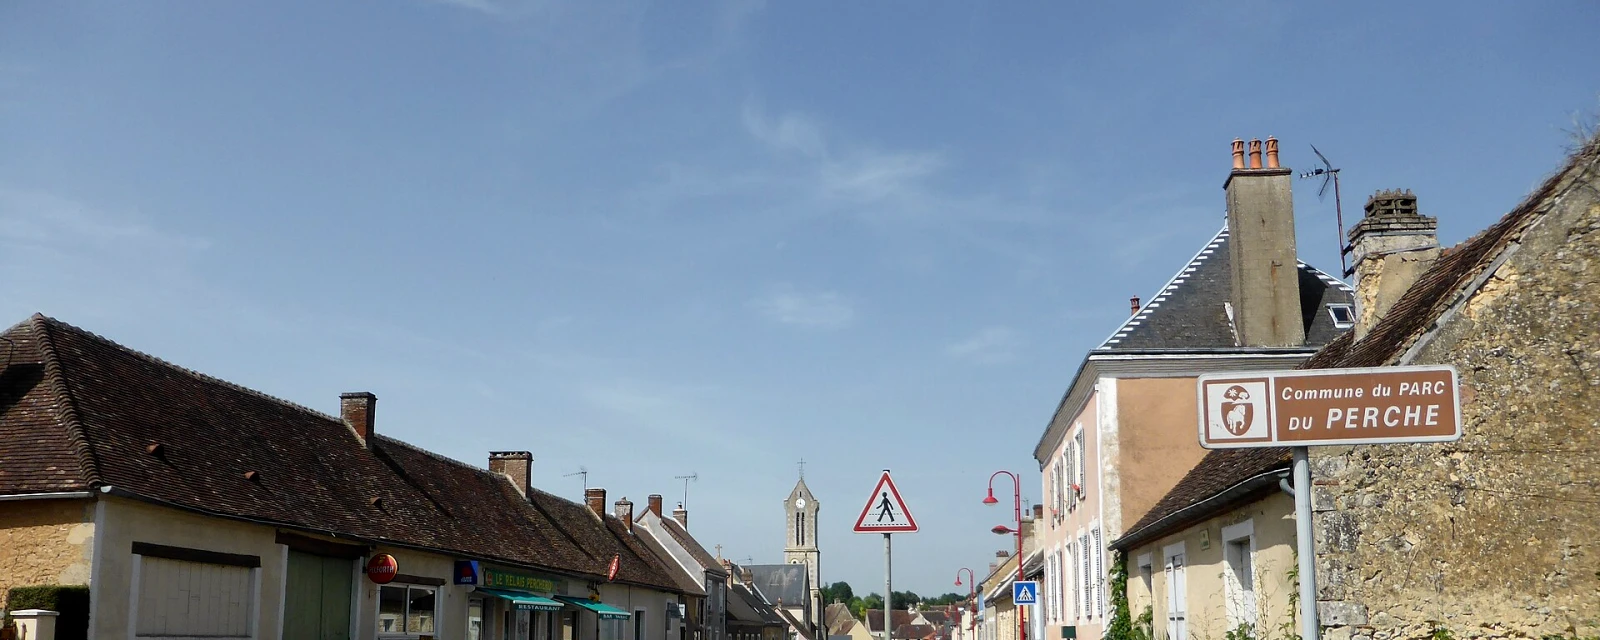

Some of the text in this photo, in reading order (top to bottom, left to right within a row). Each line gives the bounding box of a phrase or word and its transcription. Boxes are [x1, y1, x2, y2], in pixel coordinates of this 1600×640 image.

[1281, 381, 1445, 401] Commune du PARC
[1288, 404, 1440, 431] DU PERCHE
[495, 573, 503, 585] LE
[505, 574, 525, 588] RELAIS
